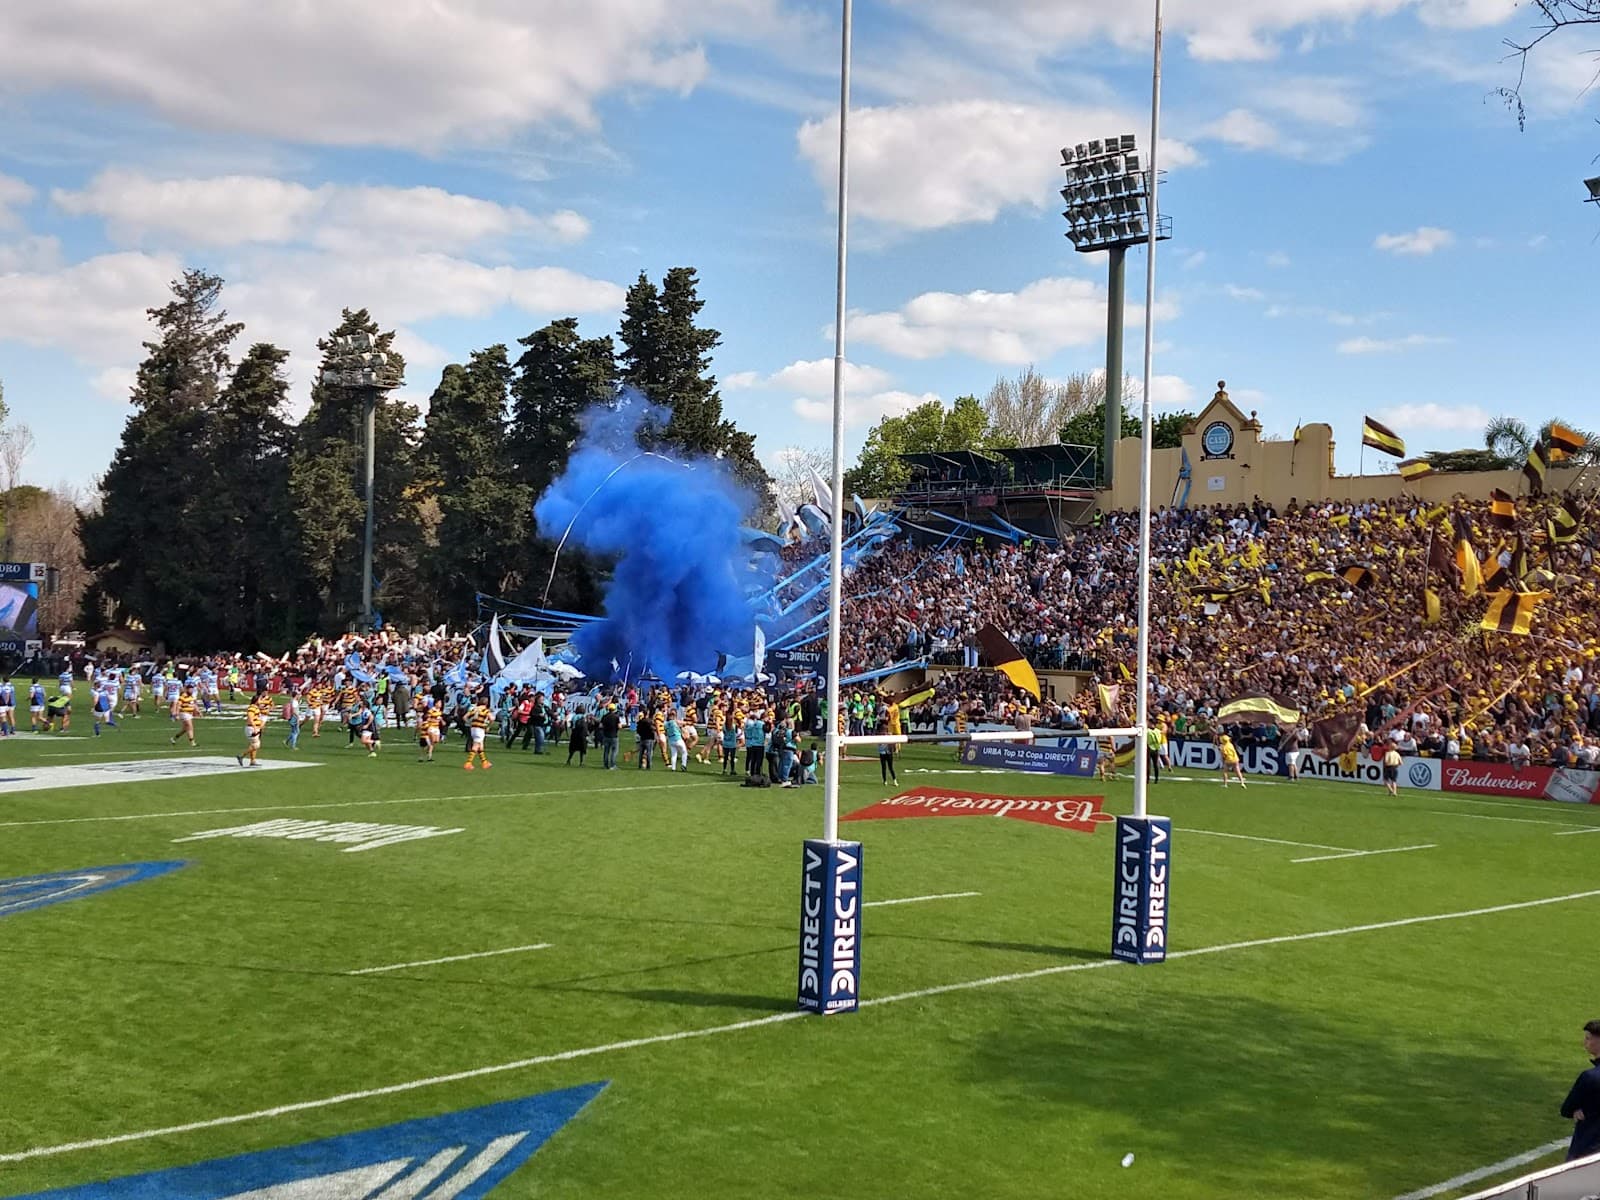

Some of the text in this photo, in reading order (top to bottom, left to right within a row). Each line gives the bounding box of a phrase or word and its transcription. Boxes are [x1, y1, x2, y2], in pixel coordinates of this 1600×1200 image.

[789, 651, 821, 662] DIRECTV
[982, 747, 1002, 755] URBA
[1003, 749, 1017, 758] Top
[1026, 752, 1043, 760] Copa
[1044, 753, 1076, 763] DIRECTV
[1169, 740, 1279, 775] MEDUS
[1446, 768, 1537, 791] Budweiser
[881, 795, 1116, 823] Budweiser
[1117, 823, 1141, 948] DIRECTV
[1146, 824, 1168, 949] DIRECTV
[801, 847, 823, 996] DIRECTV
[830, 850, 858, 997] DIRECTV
